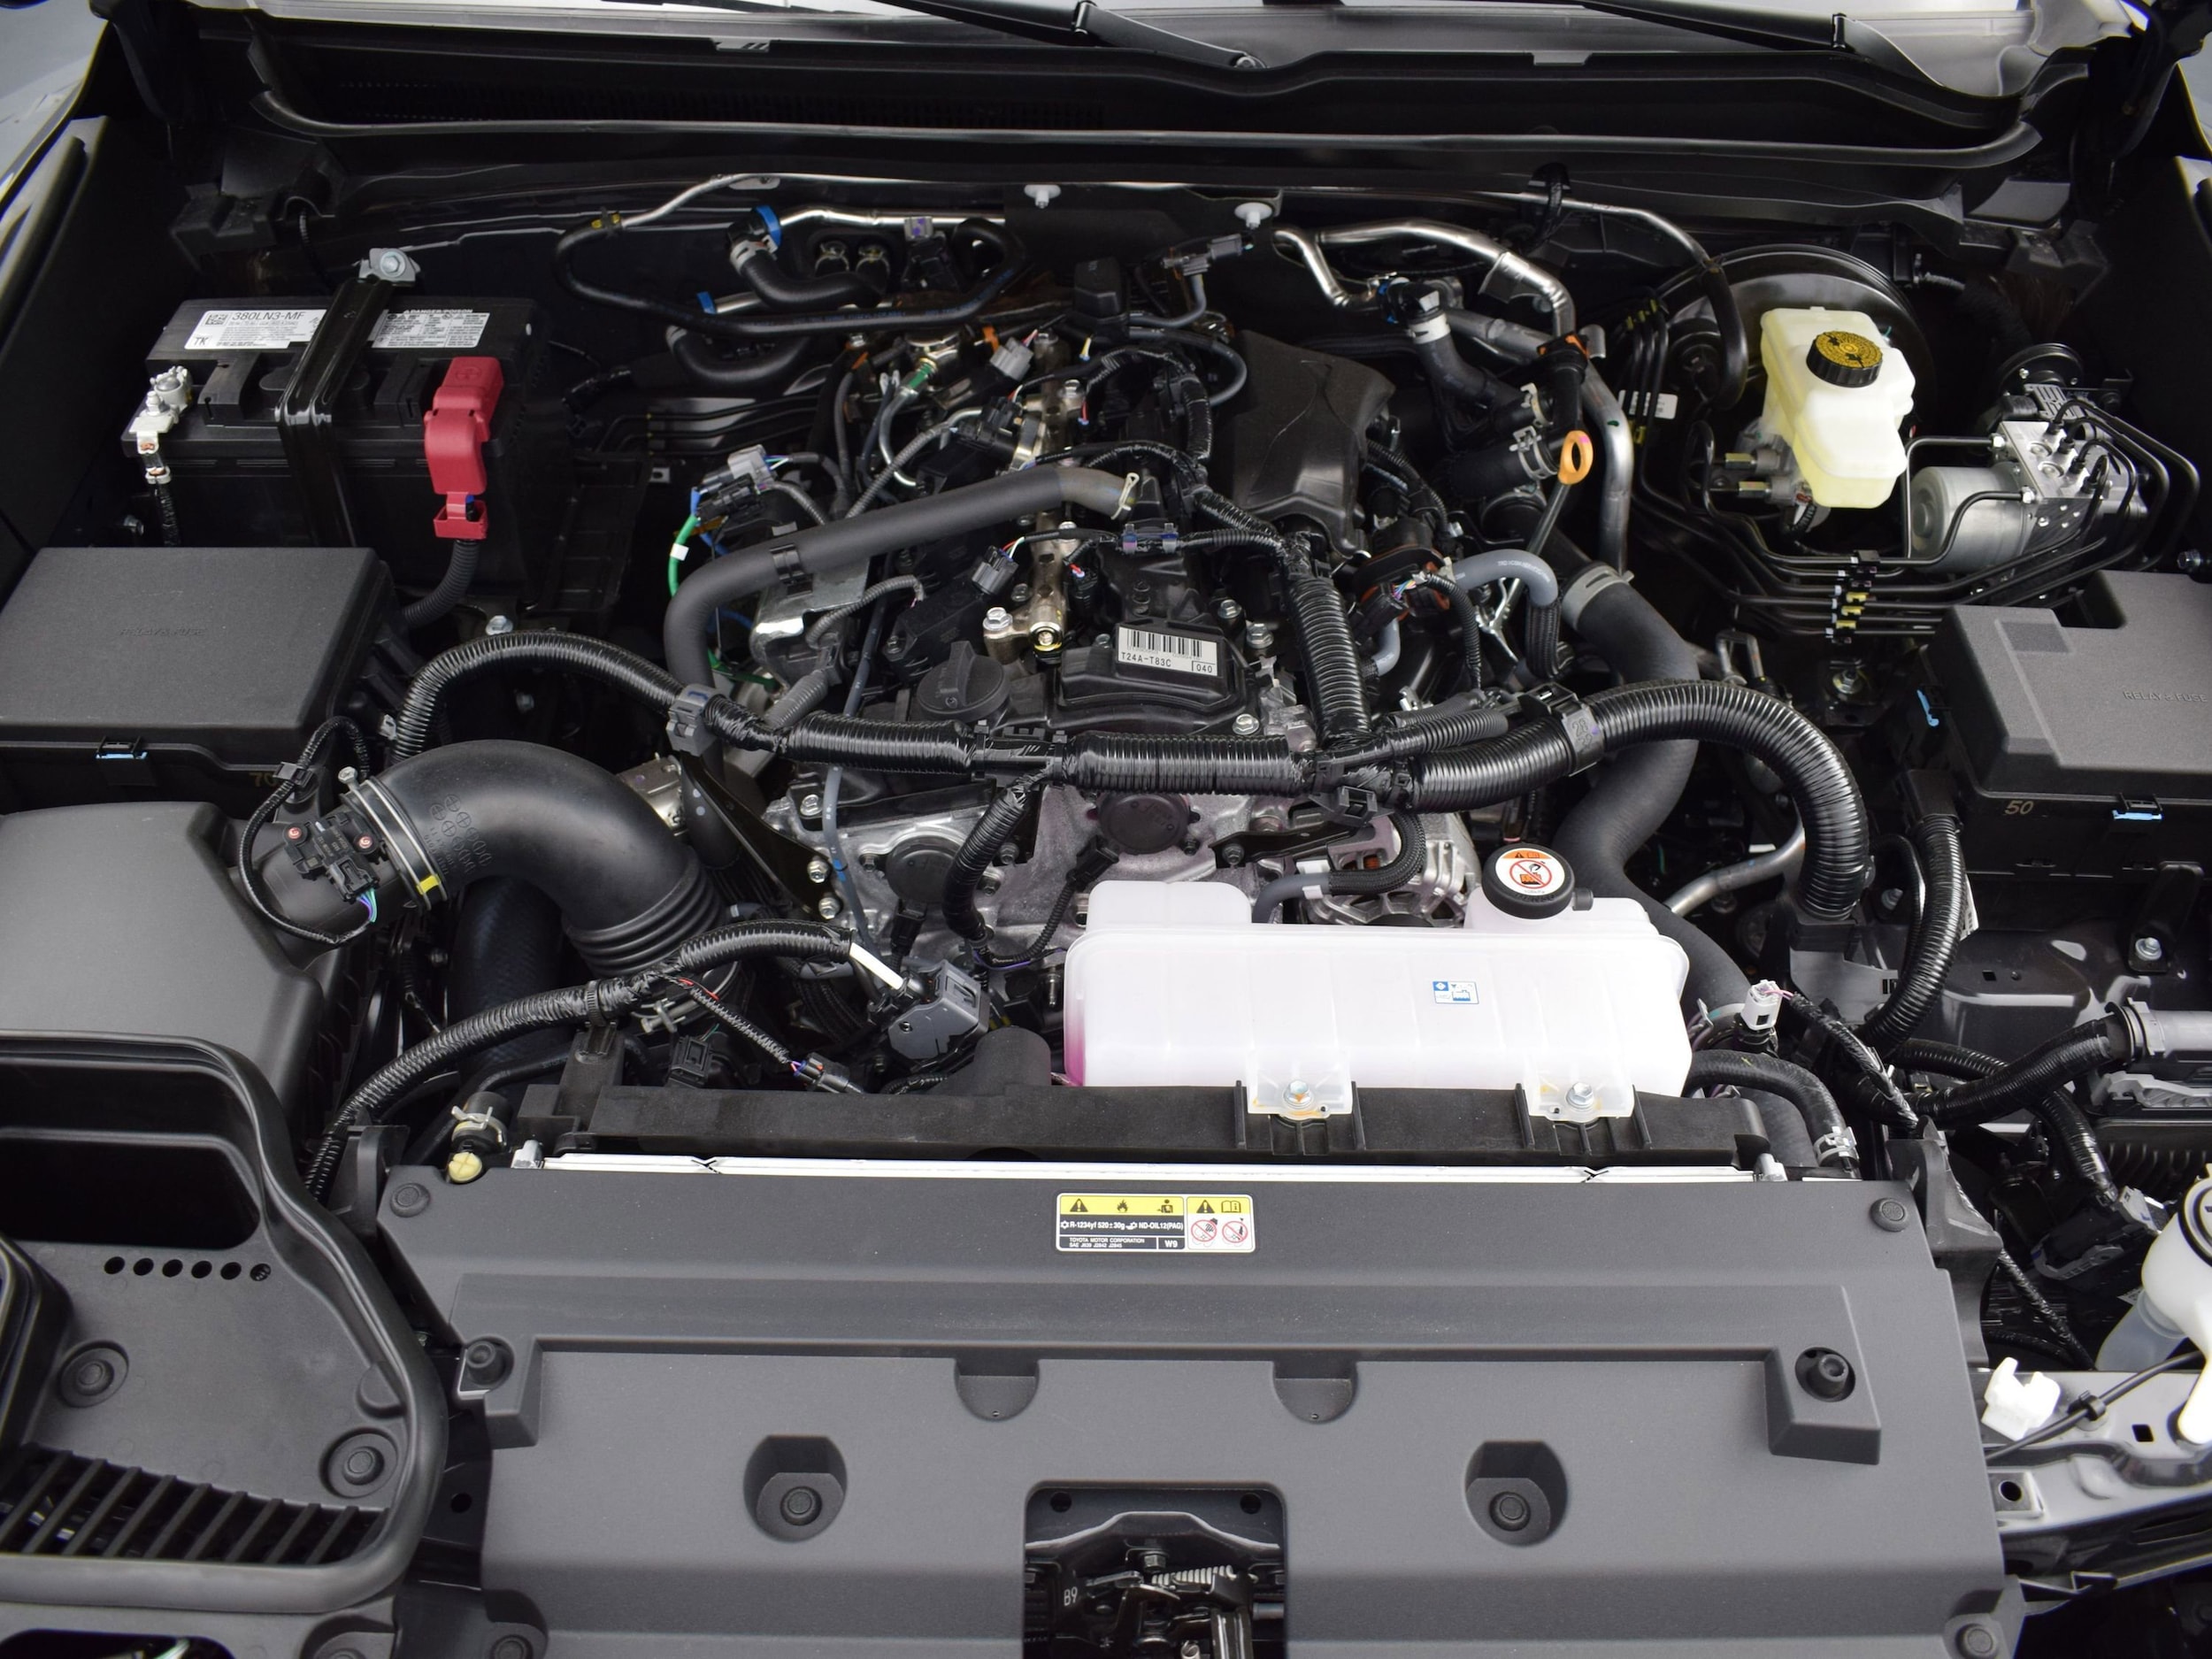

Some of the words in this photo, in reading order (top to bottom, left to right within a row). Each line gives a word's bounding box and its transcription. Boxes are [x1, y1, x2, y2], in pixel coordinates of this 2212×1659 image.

[232, 311, 305, 320] 380LN3-MF
[195, 336, 209, 346] TK
[1121, 651, 1172, 667] T24A-T83C
[1195, 664, 1213, 673] 040
[2123, 691, 2162, 701] RELAY
[2175, 693, 2208, 703] FUSE
[1571, 718, 1589, 737] 28
[2004, 800, 2034, 815] 50
[1069, 1221, 1097, 1230] R-1234yf
[1138, 1221, 1184, 1231] ND-OIL12(PAG)
[1164, 1240, 1178, 1248] W9
[1064, 1586, 1079, 1607] B9
